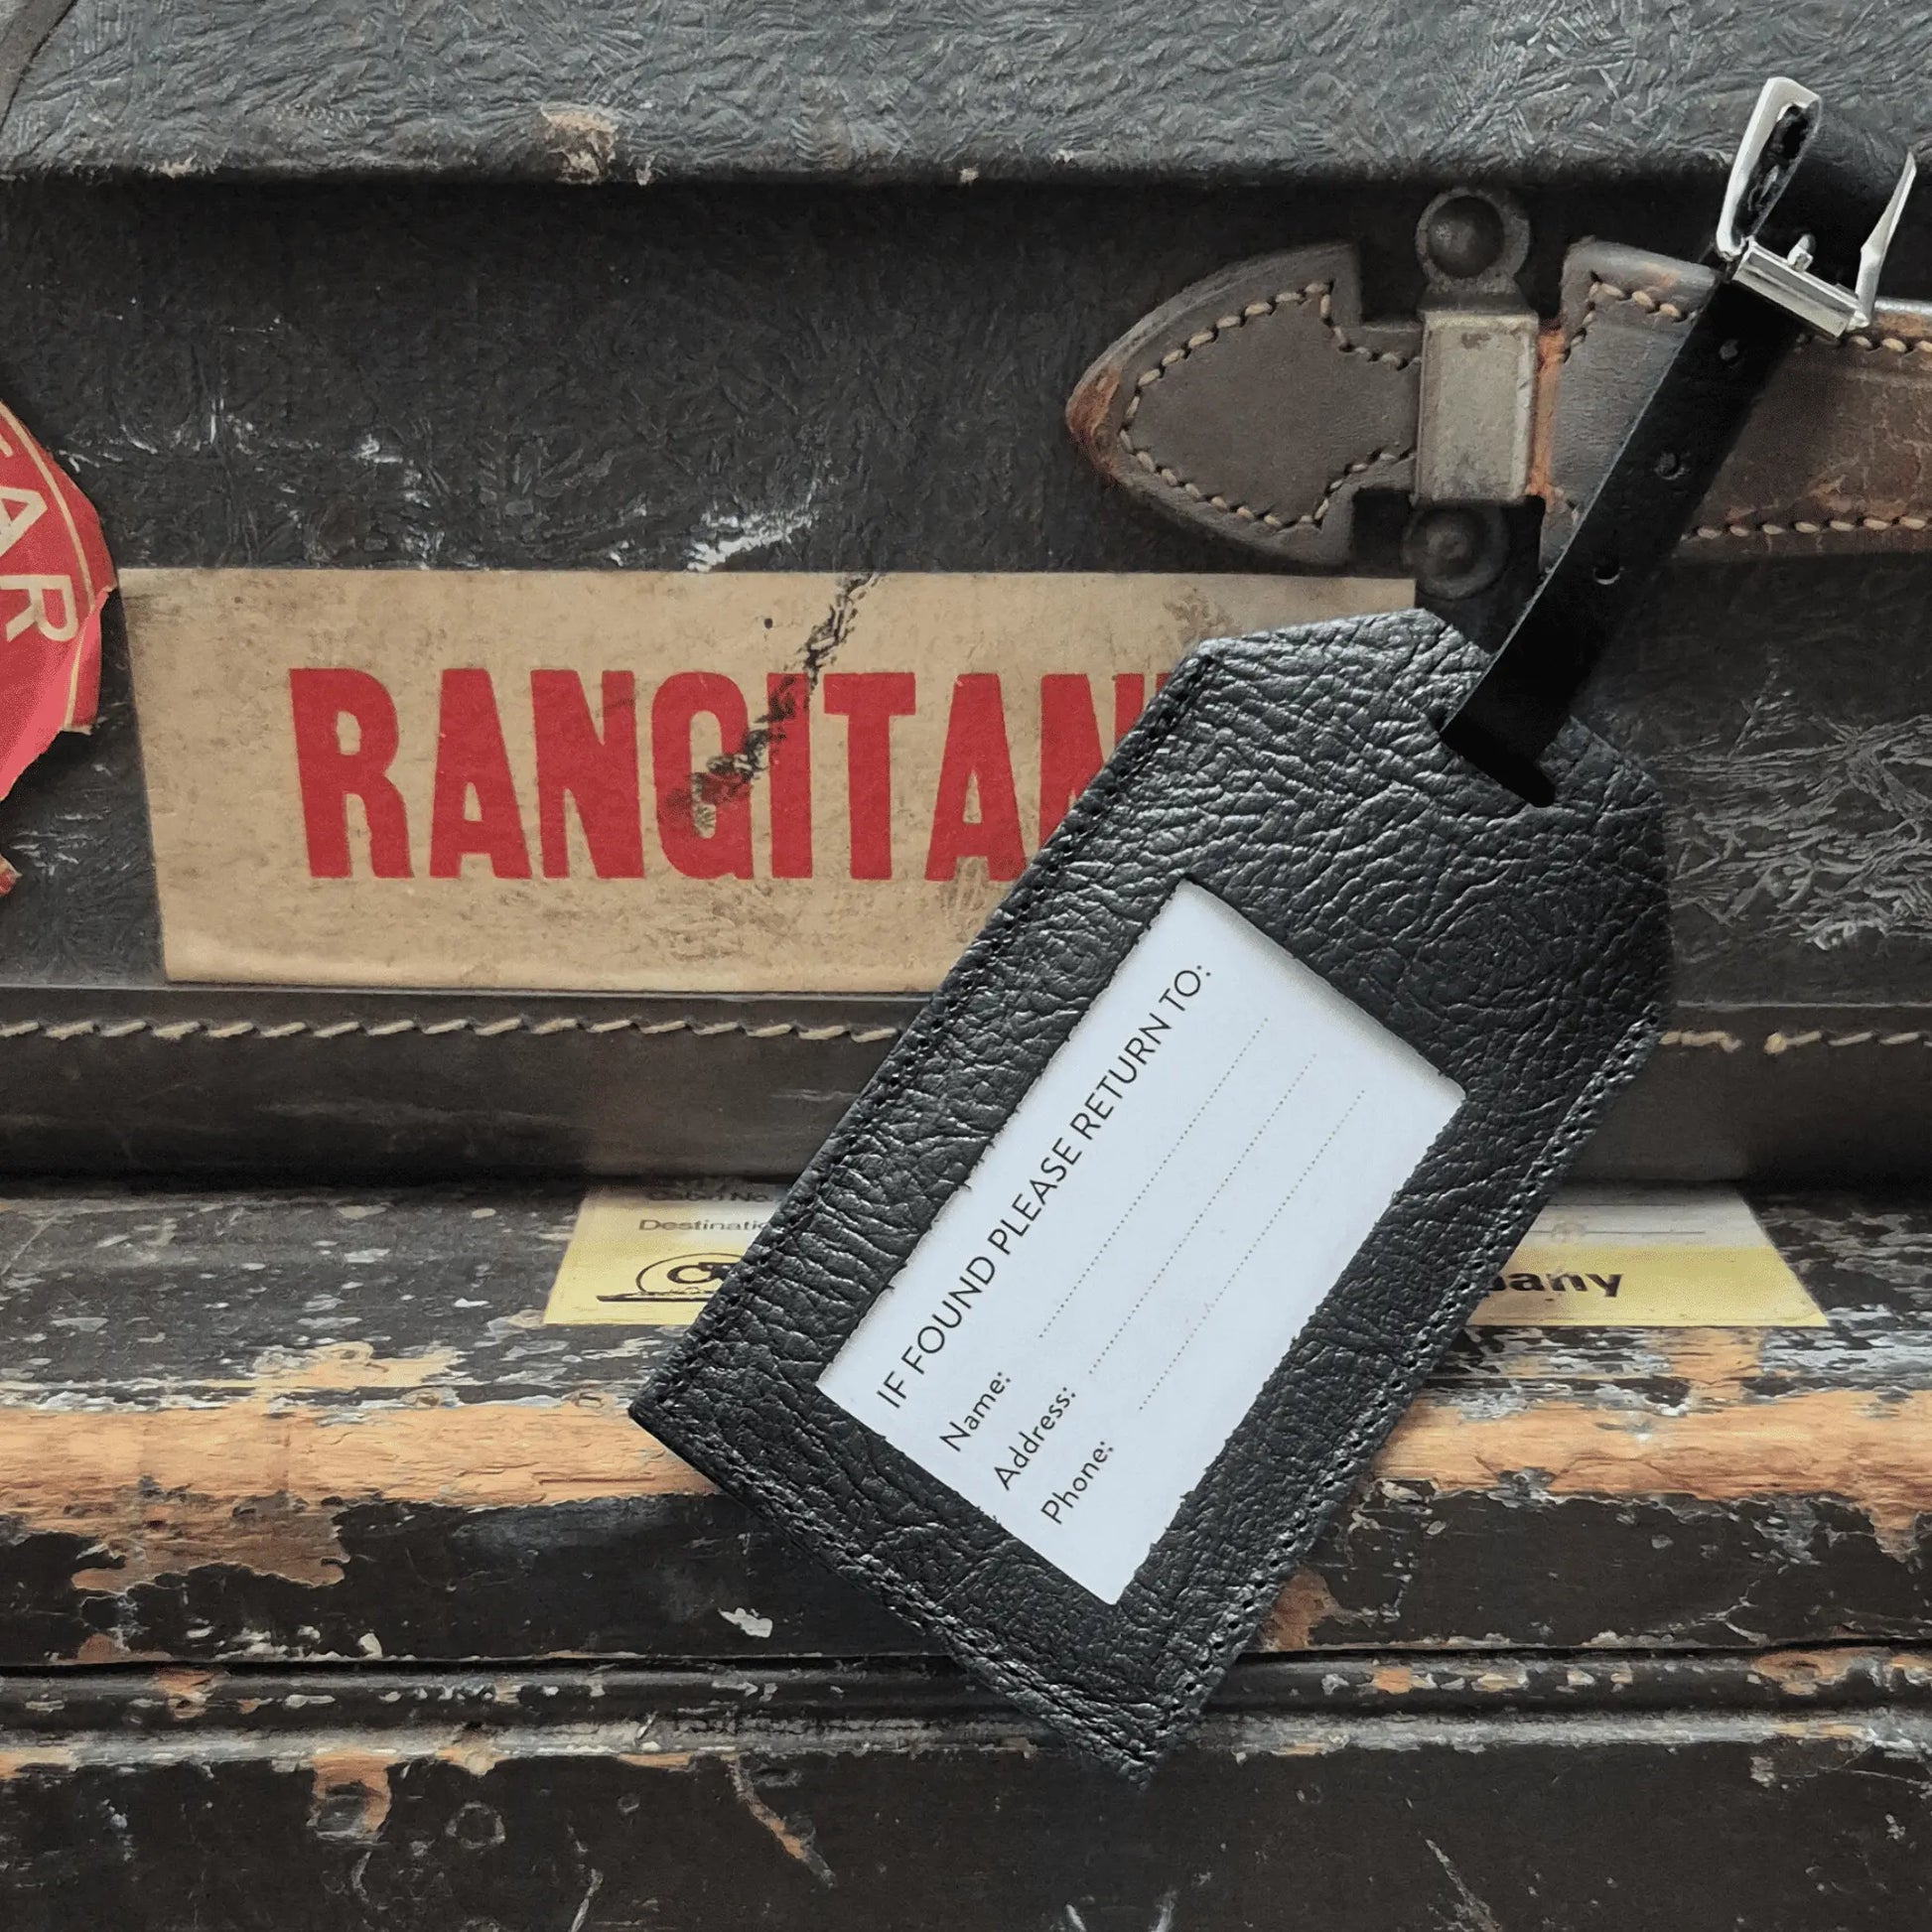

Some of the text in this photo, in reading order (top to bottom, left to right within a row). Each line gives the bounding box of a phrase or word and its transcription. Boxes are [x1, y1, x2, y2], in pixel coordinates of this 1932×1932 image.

[0, 433, 78, 642] AR
[289, 667, 1171, 881] RANGITAN
[877, 964, 1213, 1409] IF FOUND PLEASE RETURN TO:
[938, 1370, 1013, 1452] Name:
[994, 1386, 1076, 1491] Address:
[1040, 1440, 1114, 1525] Phone:
